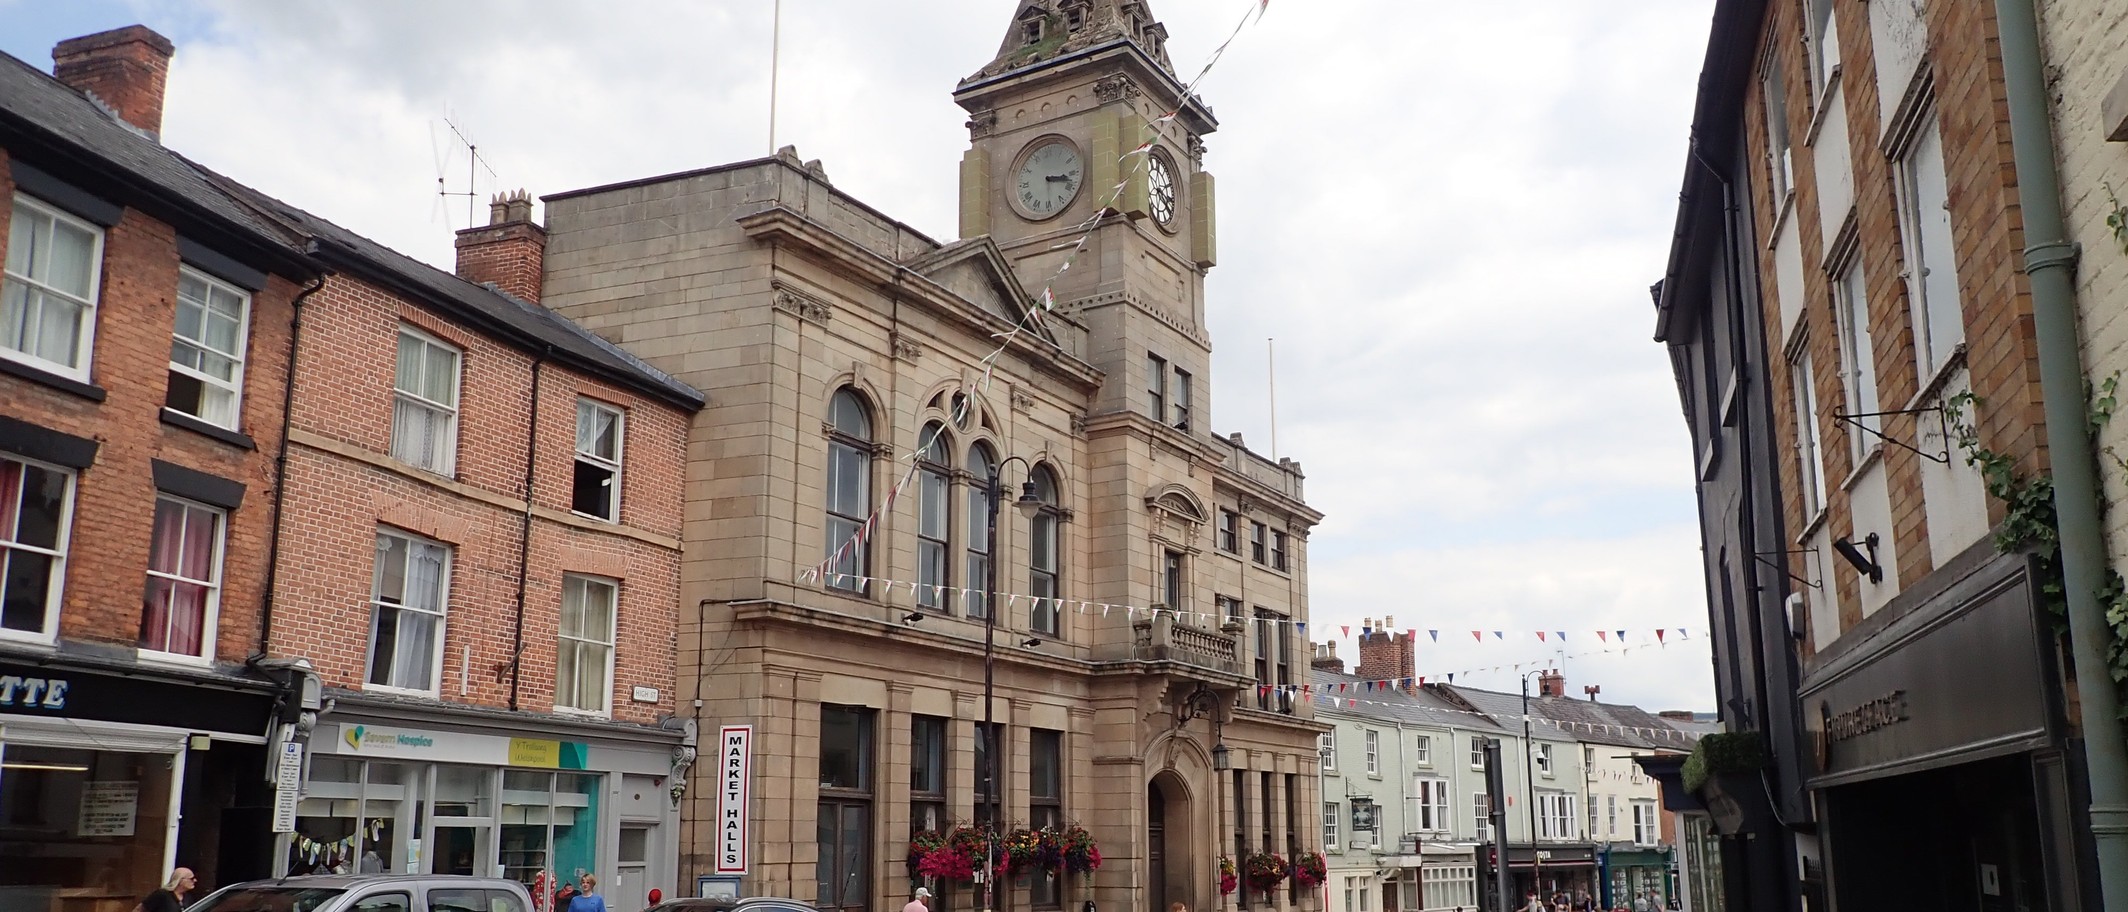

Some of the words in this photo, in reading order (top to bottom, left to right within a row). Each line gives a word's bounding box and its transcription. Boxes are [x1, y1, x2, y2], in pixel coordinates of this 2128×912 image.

[0, 675, 68, 708] TTE
[635, 690, 649, 698] HIGH
[397, 733, 434, 747] Hospice
[728, 736, 742, 801] MARKET
[726, 809, 738, 863] HALLS
[1536, 850, 1551, 860] COSTA
